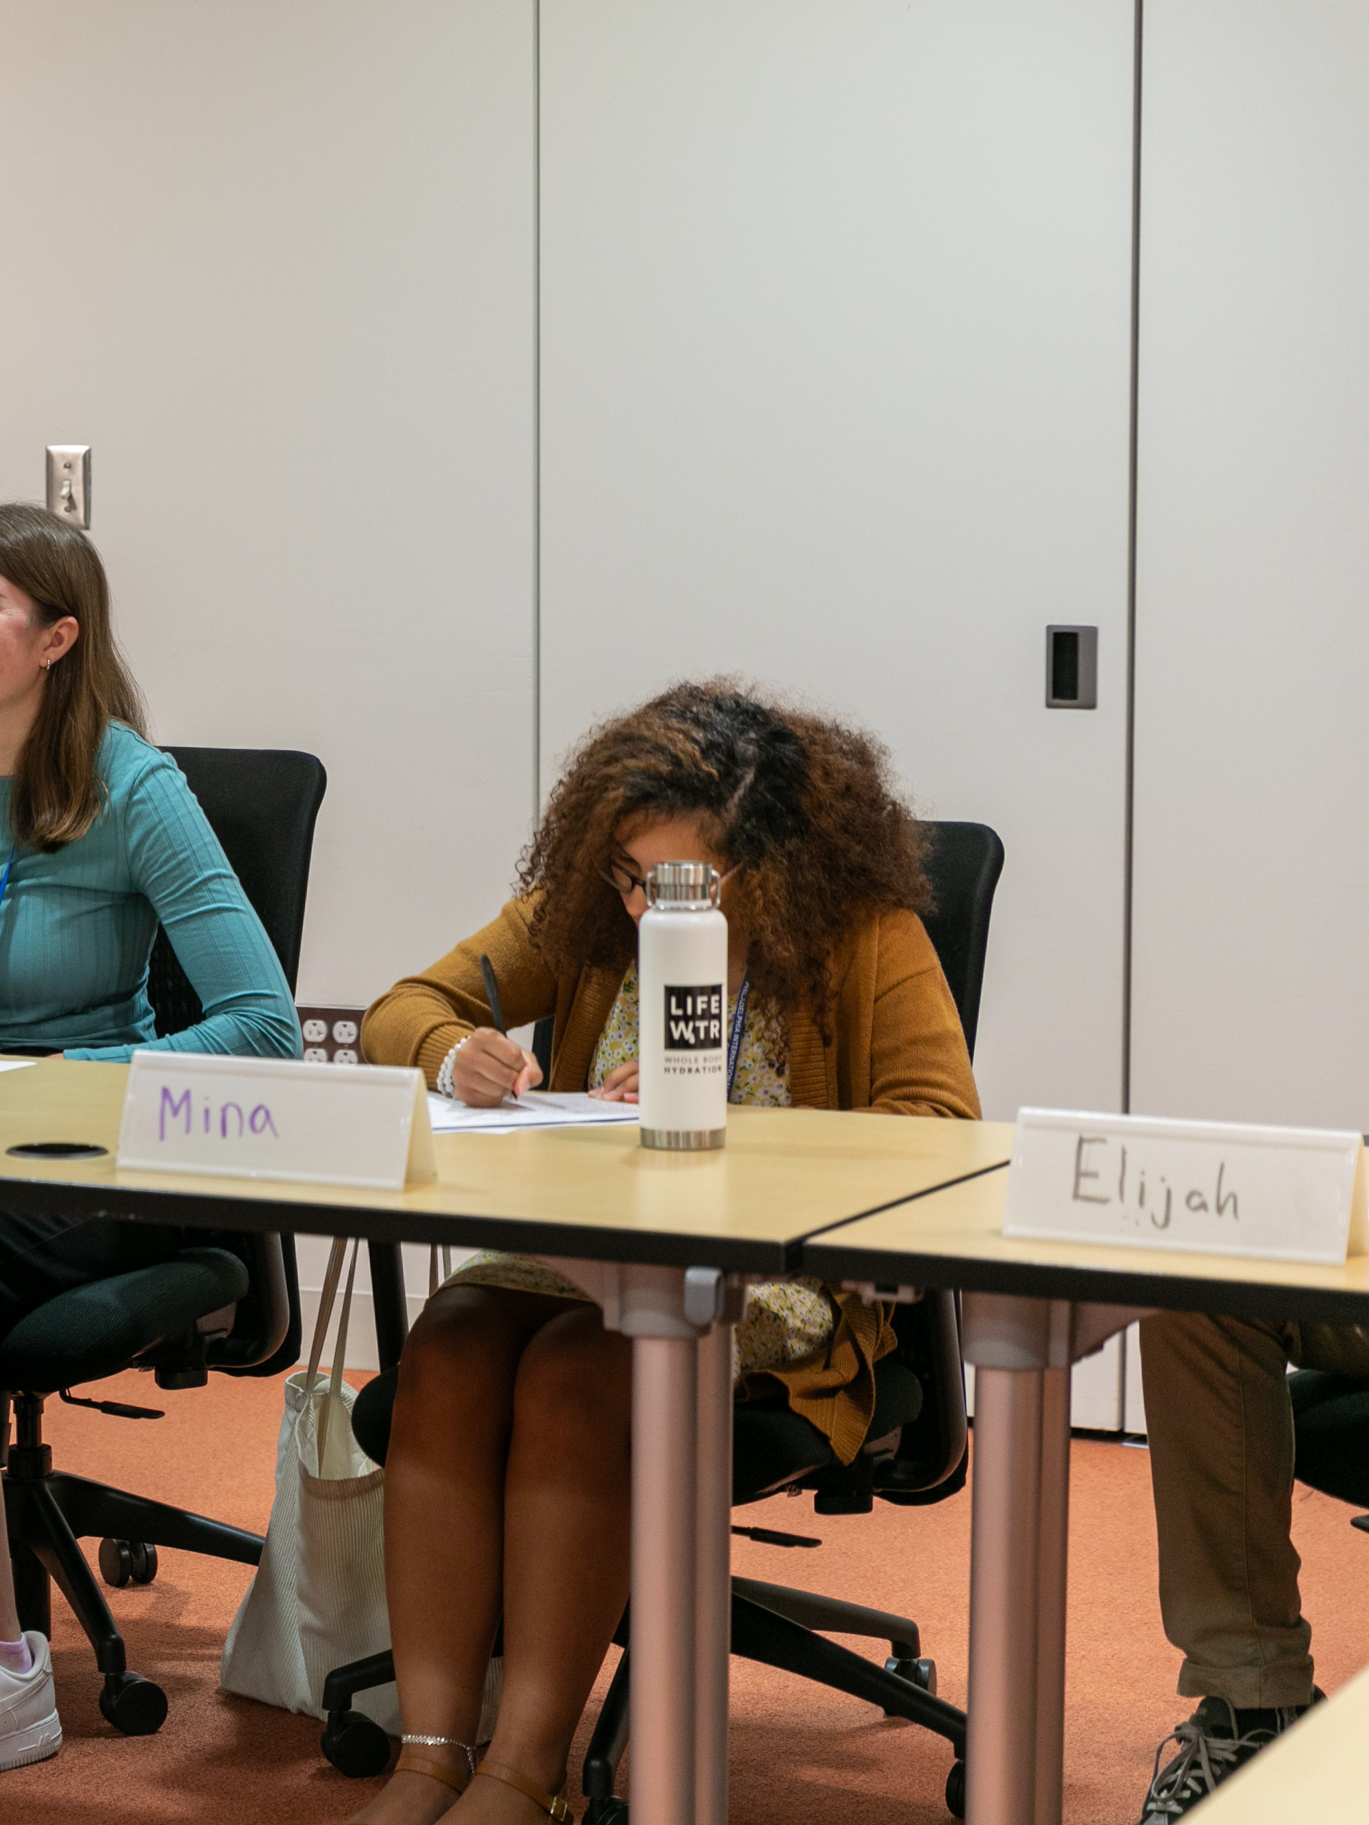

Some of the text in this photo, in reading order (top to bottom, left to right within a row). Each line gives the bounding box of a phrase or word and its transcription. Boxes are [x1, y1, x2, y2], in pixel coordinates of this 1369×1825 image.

[670, 995, 720, 1015] LIFE
[663, 1054, 723, 1065] WHOLE BODY
[663, 1065, 723, 1075] HYDRATION
[158, 1085, 279, 1142] Mina
[1071, 1135, 1240, 1230] Elijah
